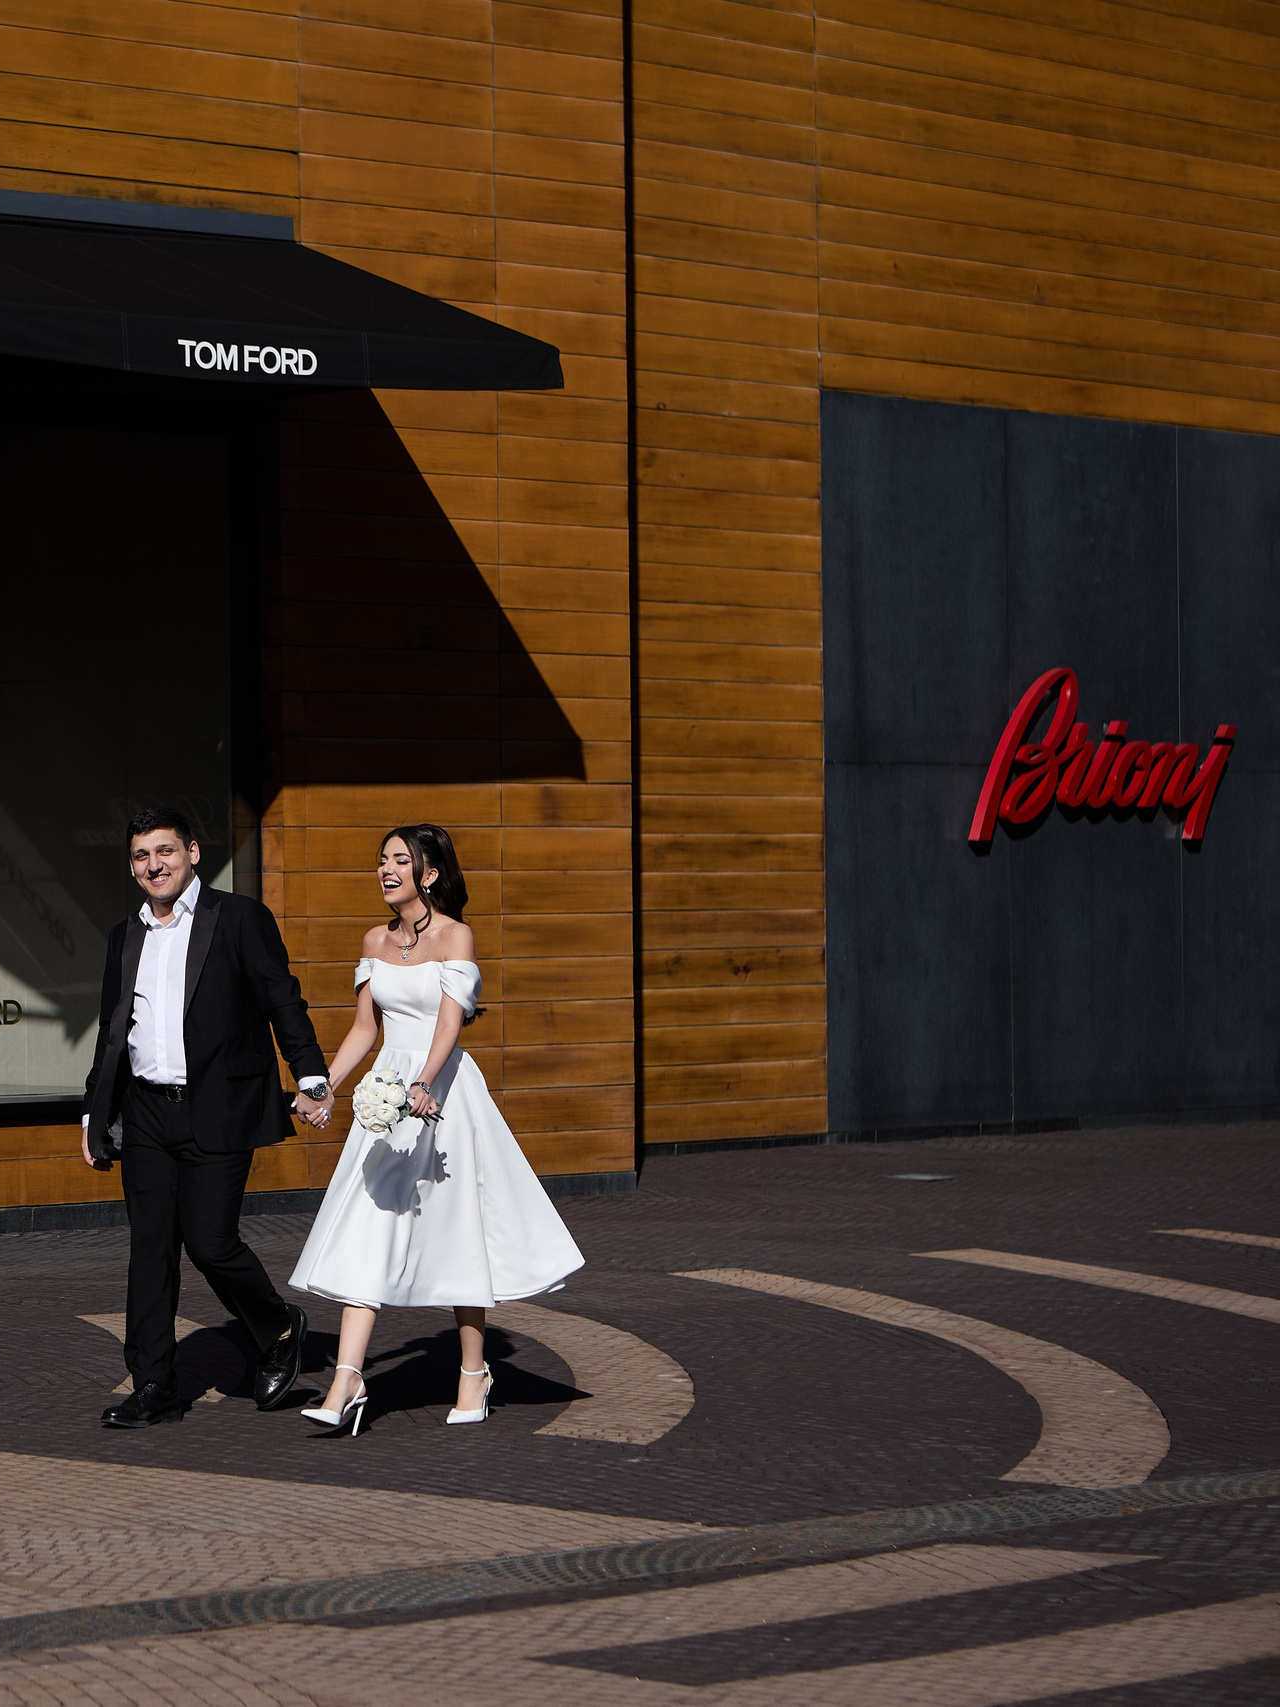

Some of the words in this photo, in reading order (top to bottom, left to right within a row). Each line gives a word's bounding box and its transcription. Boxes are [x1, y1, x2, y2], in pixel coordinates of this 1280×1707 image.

[177, 338, 238, 371] TOM
[243, 344, 318, 376] FORD
[967, 667, 1238, 852] Brioni
